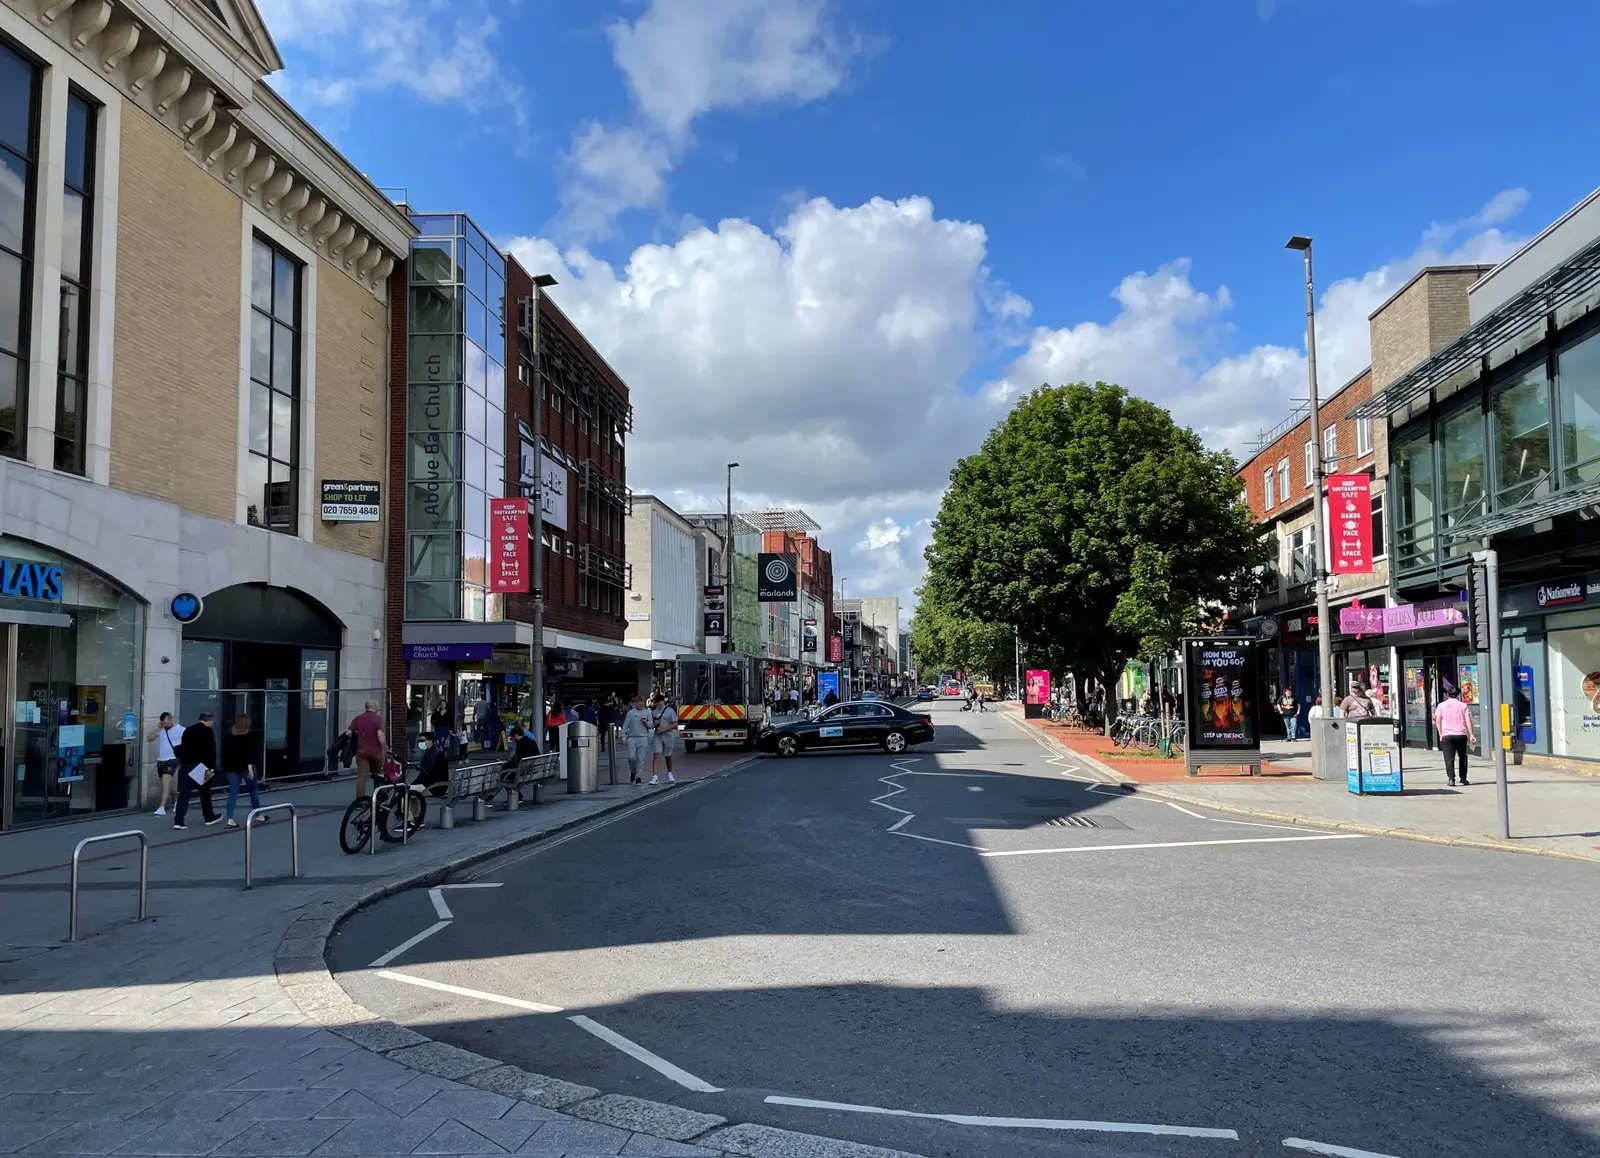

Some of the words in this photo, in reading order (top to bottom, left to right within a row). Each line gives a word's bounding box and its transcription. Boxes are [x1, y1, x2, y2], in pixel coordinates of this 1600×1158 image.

[425, 354, 440, 418] Church
[425, 424, 440, 454] Bar
[324, 484, 378, 492] green&partners
[425, 460, 440, 515] Above
[359, 507, 378, 515] 4848
[759, 589, 795, 597] marlands
[1546, 582, 1581, 600] Nationwide
[1202, 651, 1220, 659] HOW
[1221, 650, 1237, 659] HOT
[1211, 658, 1229, 667] YOU
[1229, 656, 1246, 666] GO?
